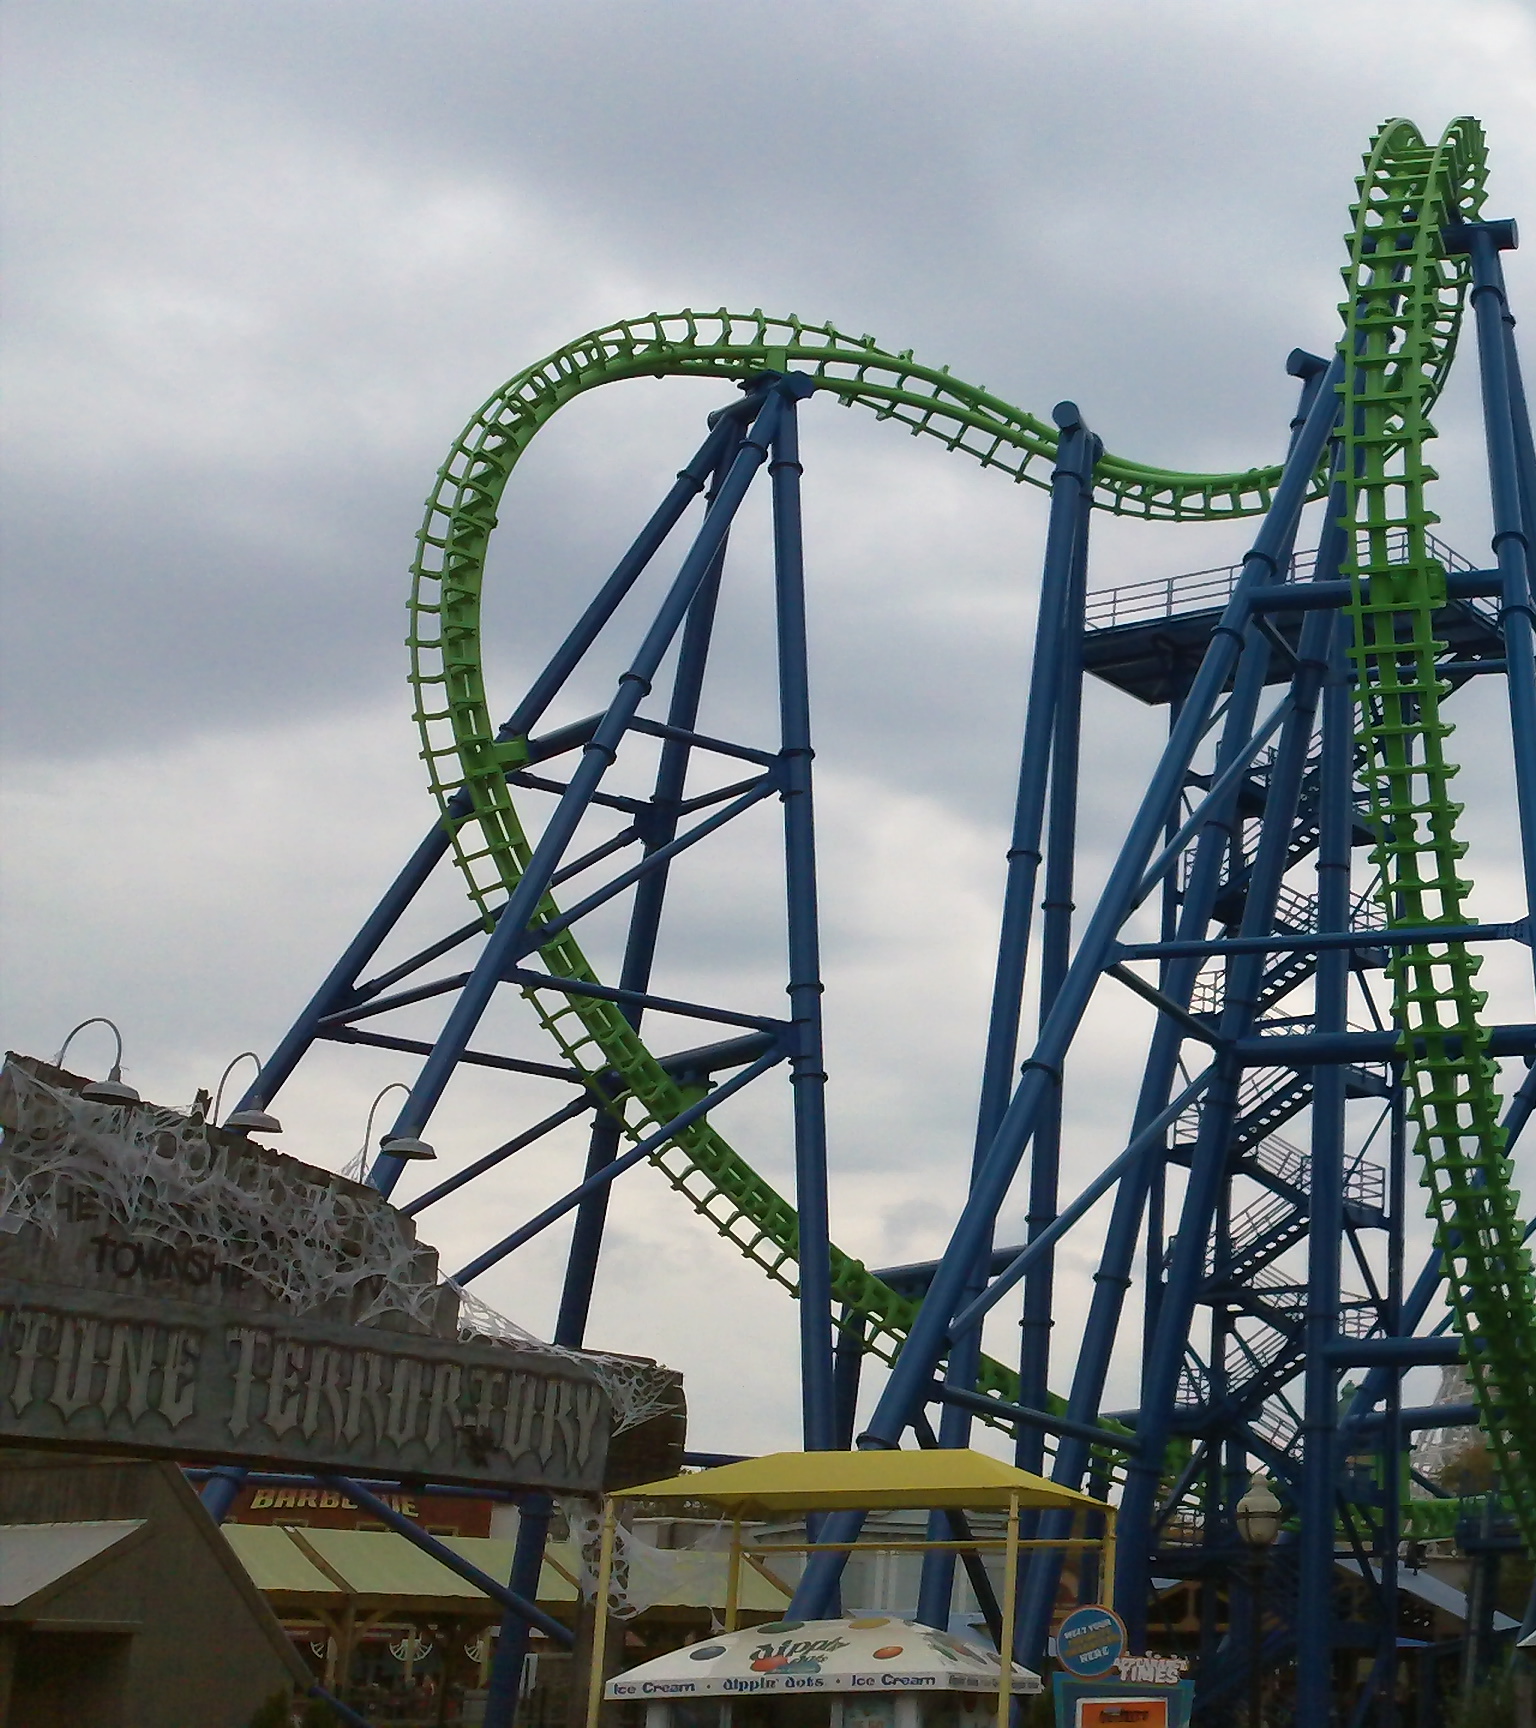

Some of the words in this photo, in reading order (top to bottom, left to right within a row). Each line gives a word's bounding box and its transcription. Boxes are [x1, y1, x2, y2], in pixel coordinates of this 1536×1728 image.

[250, 1487, 419, 1518] BARBEUE
[613, 1682, 637, 1695] Ice
[642, 1681, 696, 1694] Cream
[784, 1675, 824, 1688] dots
[851, 1674, 875, 1687] Ice
[880, 1673, 936, 1687] Cream
